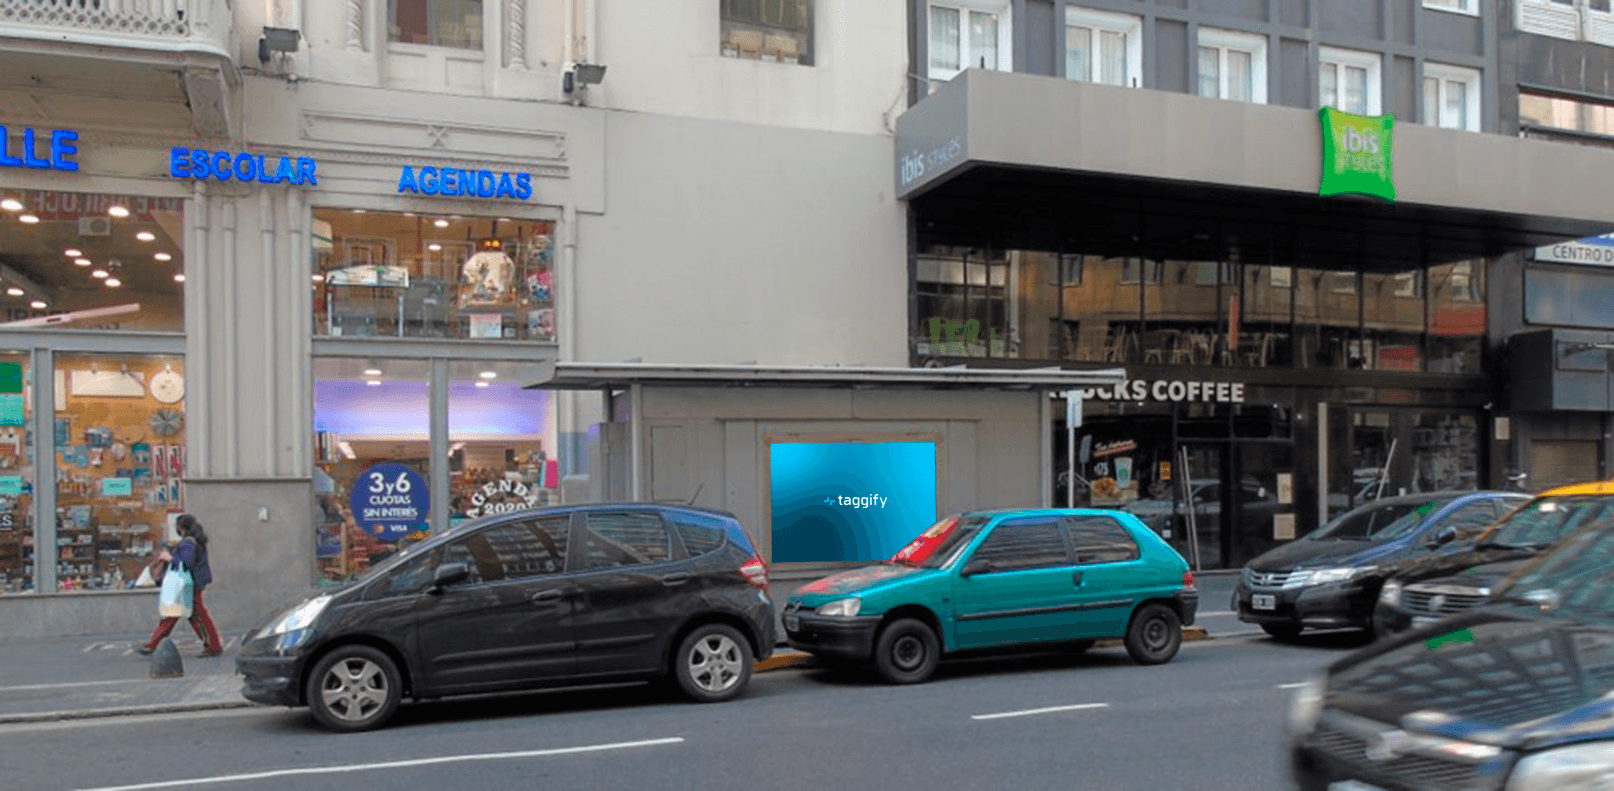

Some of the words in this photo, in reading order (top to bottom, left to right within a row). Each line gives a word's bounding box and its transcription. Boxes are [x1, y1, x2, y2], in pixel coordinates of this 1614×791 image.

[1342, 126, 1380, 154] ibis
[170, 147, 317, 185] ESCOLAR
[901, 149, 925, 185] ibis
[398, 165, 533, 200] AGENDAS
[1552, 244, 1602, 262] CENTRO
[1151, 380, 1246, 403] COFFEE
[369, 495, 411, 506] CUOTAS
[484, 502, 527, 515] 2020
[837, 493, 888, 509] taggify
[363, 507, 381, 517] SIN
[381, 505, 418, 517] INTERÉS
